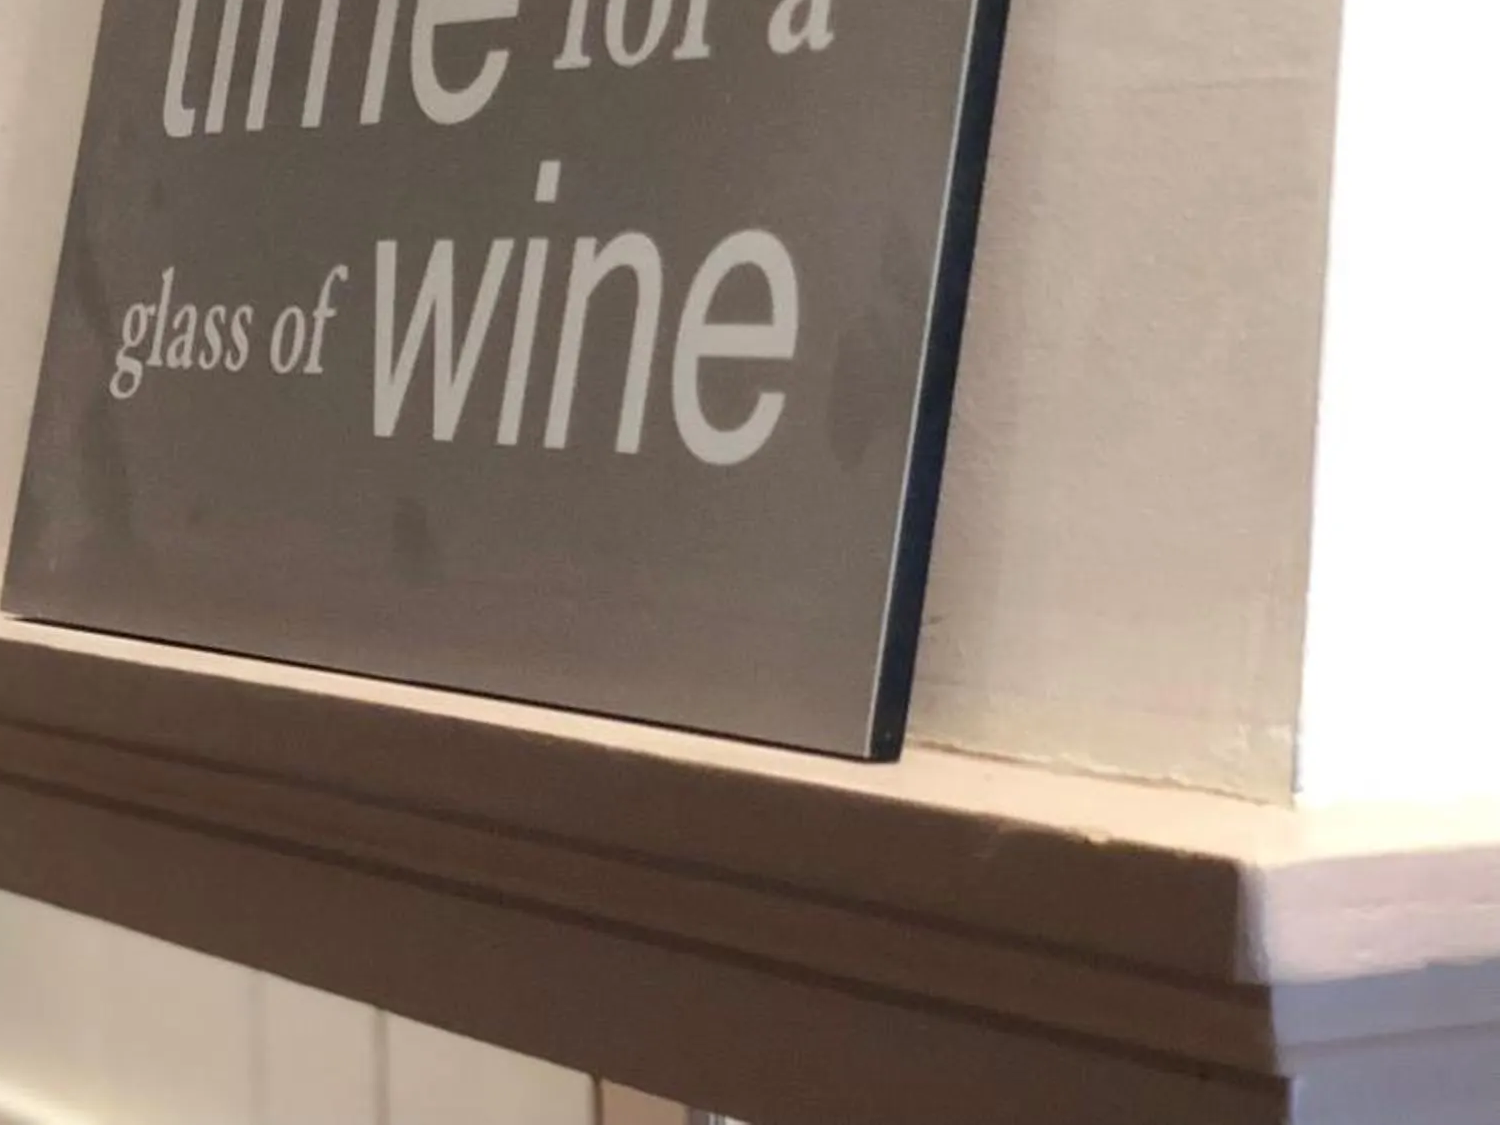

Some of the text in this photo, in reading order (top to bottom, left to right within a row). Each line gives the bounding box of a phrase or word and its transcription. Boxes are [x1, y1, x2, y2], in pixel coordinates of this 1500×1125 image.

[109, 161, 799, 465] glass of wine
